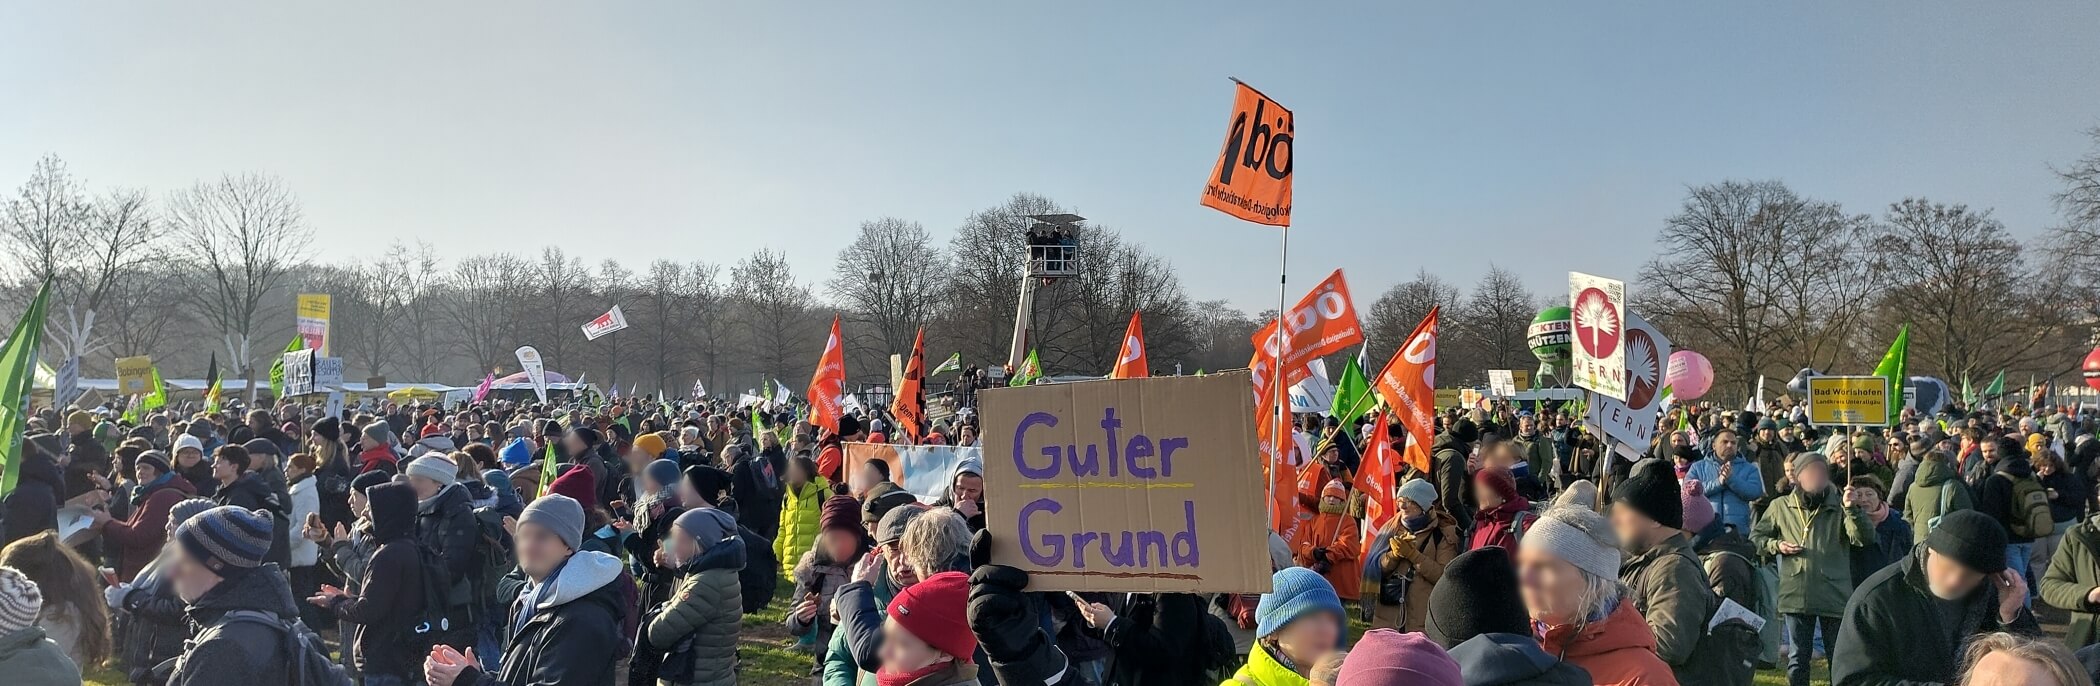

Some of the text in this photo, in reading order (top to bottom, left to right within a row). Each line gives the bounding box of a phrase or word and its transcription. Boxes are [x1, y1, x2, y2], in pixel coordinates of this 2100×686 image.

[1814, 388, 1831, 396] Bad
[1012, 407, 1189, 480] Guter
[1018, 498, 1200, 569] Grund
